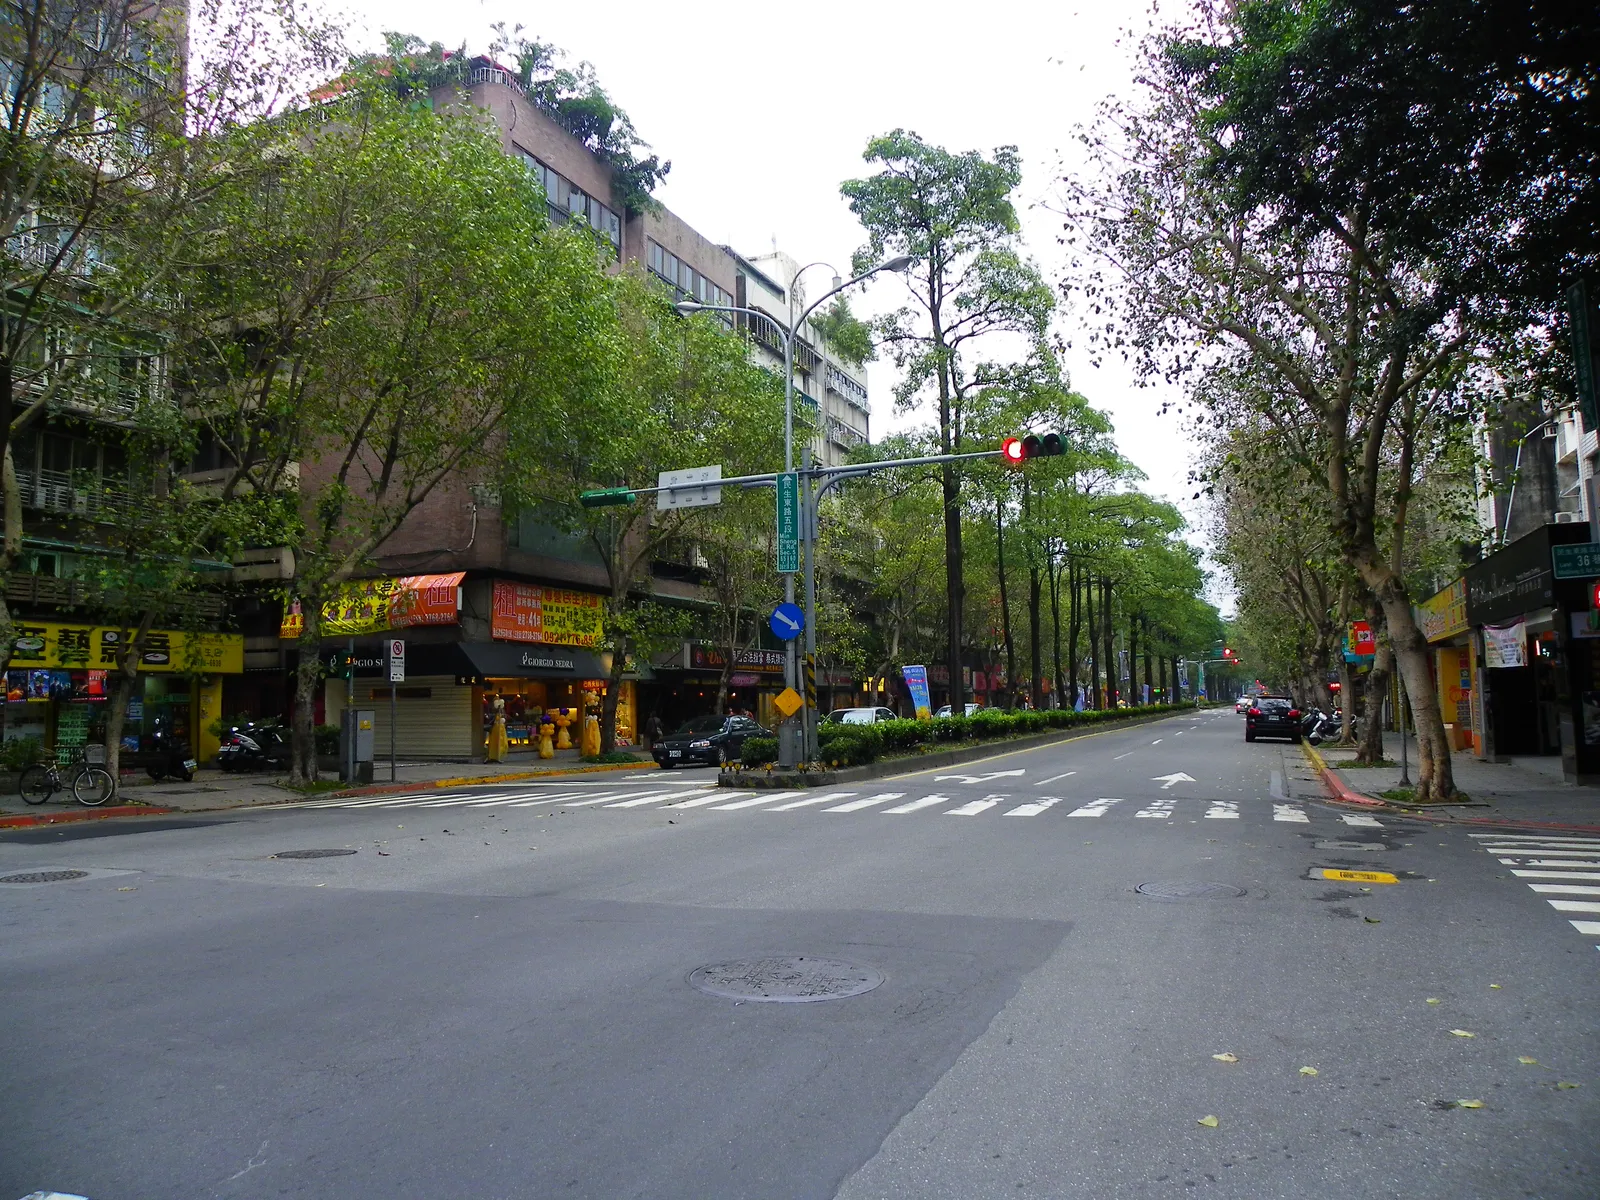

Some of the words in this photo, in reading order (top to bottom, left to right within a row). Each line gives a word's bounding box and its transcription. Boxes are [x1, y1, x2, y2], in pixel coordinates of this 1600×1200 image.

[783, 480, 793, 533] 民生東路五段
[1576, 554, 1590, 566] 36
[424, 576, 456, 607] 租
[494, 583, 517, 618] 租
[528, 657, 554, 667] GIORGIO
[555, 659, 574, 669] SEDRA
